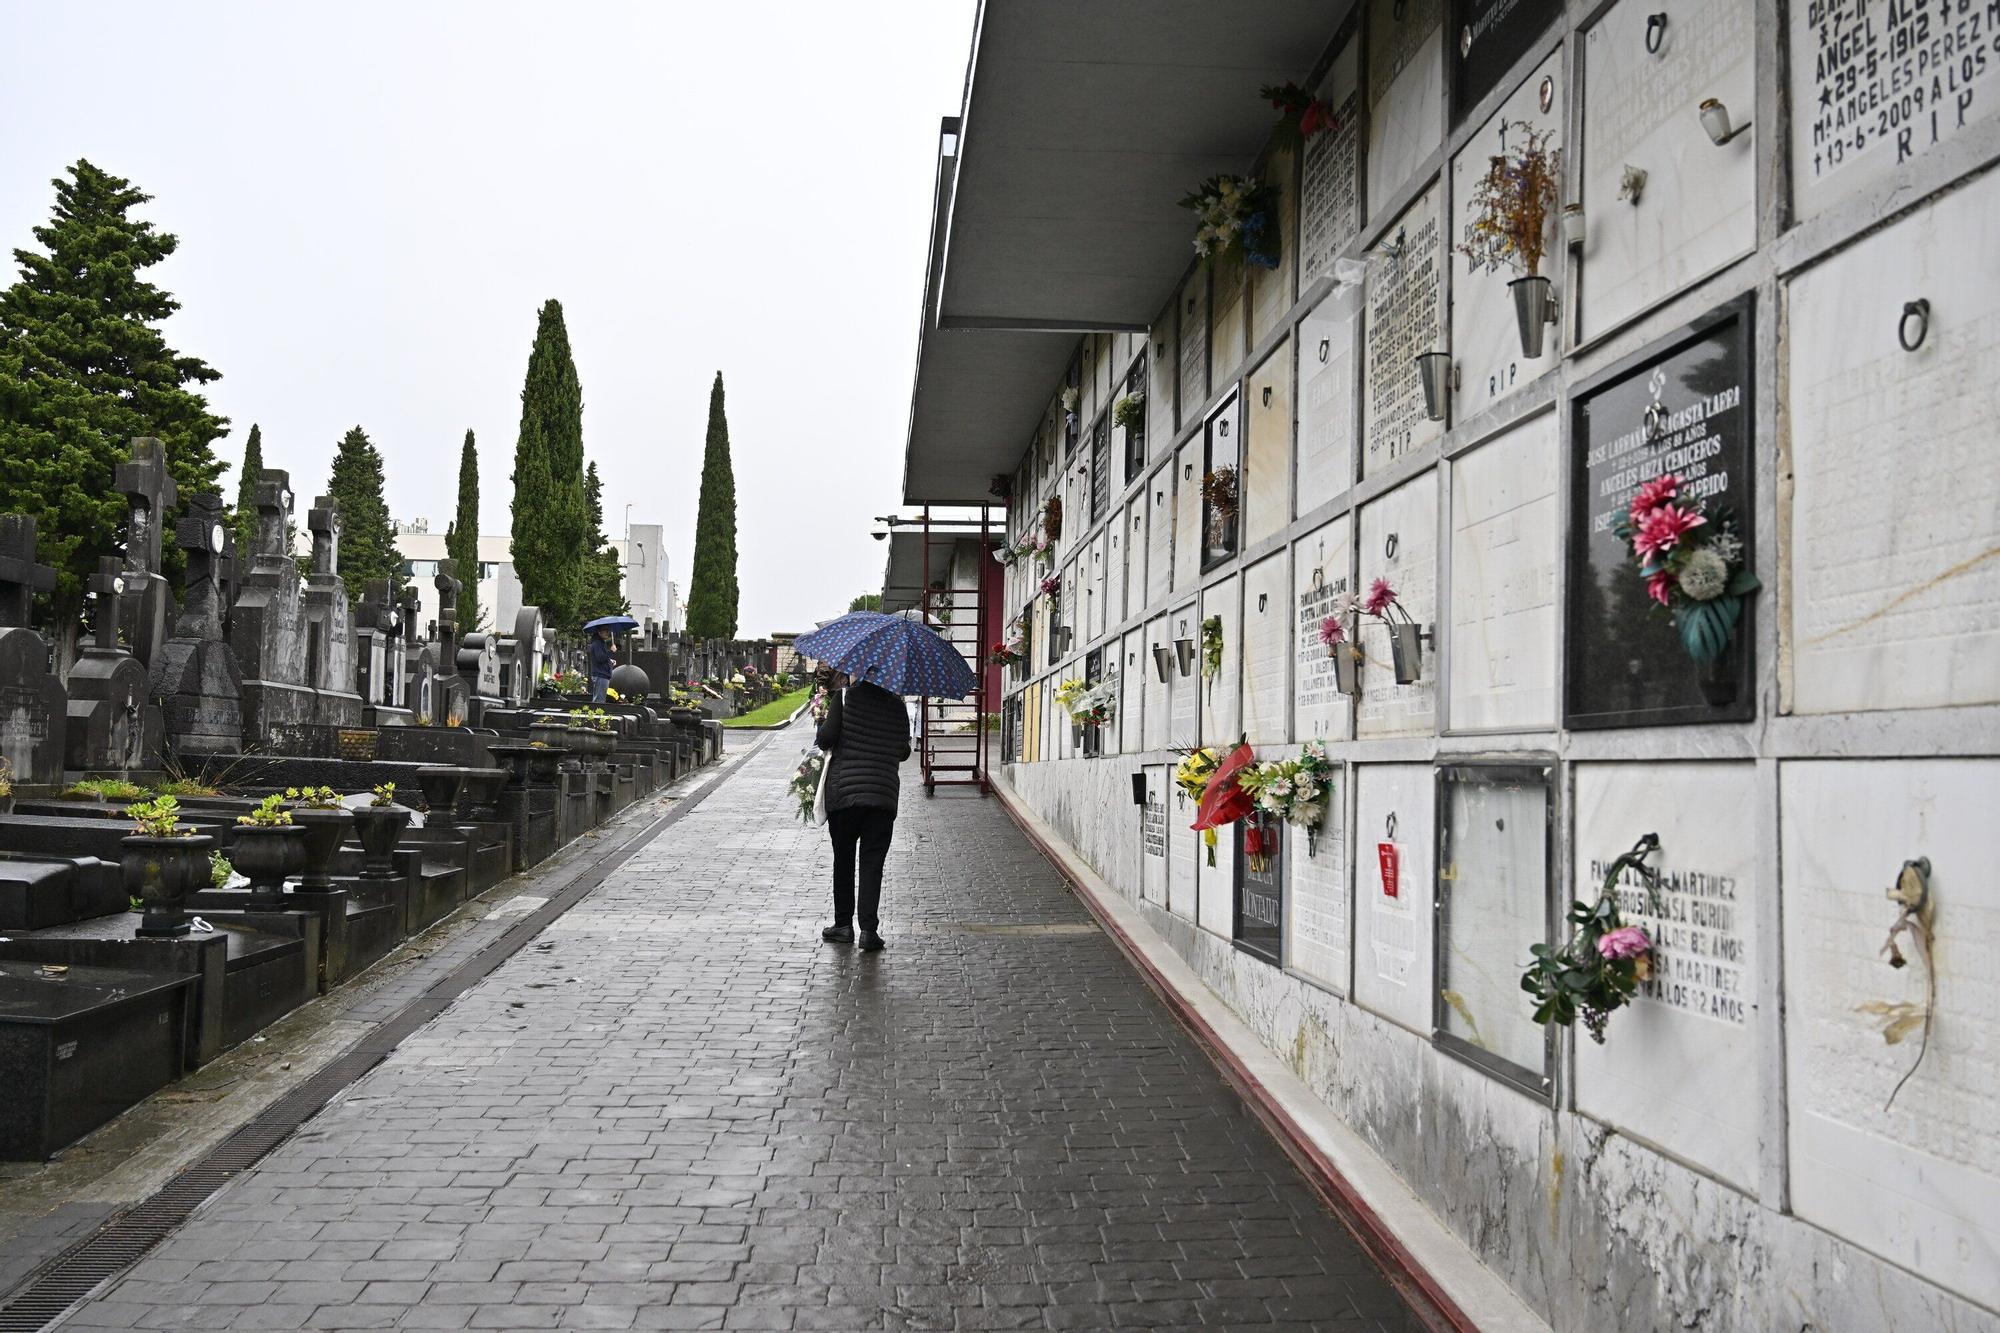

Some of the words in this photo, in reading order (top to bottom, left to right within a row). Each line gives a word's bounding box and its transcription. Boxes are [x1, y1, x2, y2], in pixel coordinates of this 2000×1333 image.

[1816, 17, 1877, 84] ANGEL
[1834, 12, 1930, 101] 29-5-1912
[1836, 58, 1913, 132] ANGELES
[1918, 12, 1981, 76] PEREZ
[1827, 86, 1924, 168] 13-6-2009
[1930, 75, 1942, 104] A
[1949, 45, 1987, 93] LOS
[1666, 982, 1688, 1009] LOS
[1712, 991, 1744, 1024] AÑOS
